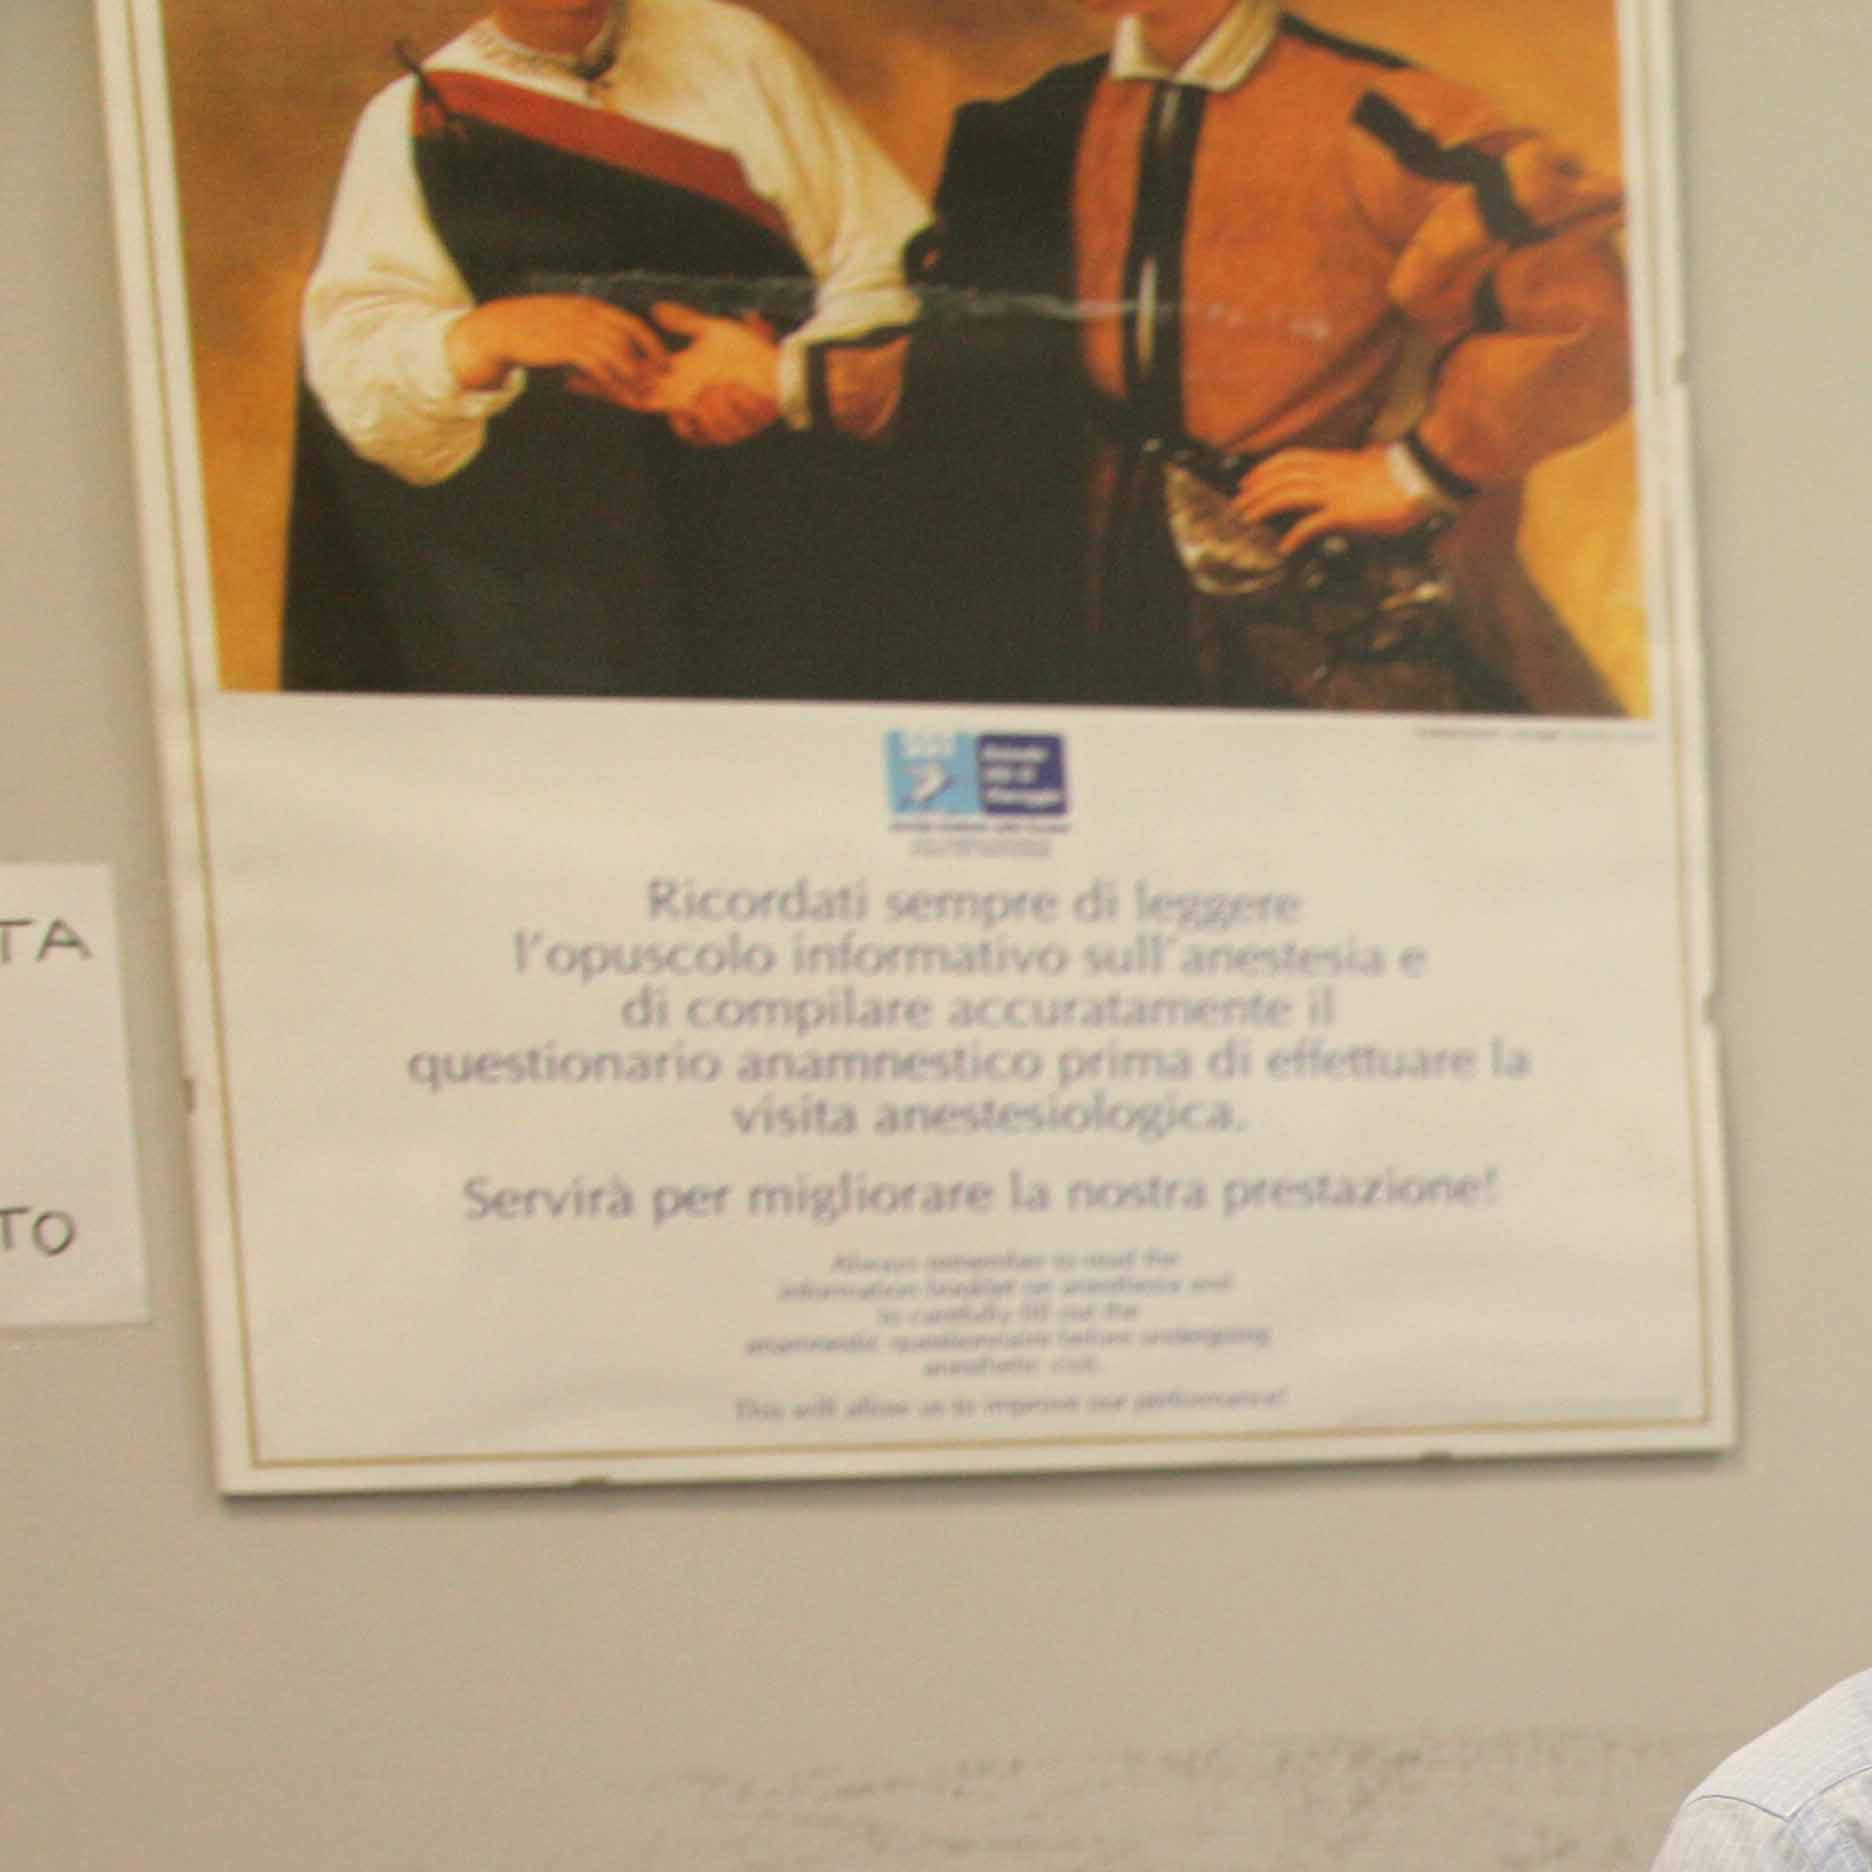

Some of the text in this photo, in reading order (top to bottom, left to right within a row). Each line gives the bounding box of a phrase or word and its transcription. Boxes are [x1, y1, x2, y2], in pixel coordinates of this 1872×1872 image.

[648, 878, 1304, 931] Ricordati sempre di leggere
[793, 929, 1069, 976] informativo
[1397, 942, 1427, 977] e
[620, 984, 1335, 1036] di compilare accuratamente il
[406, 1036, 1532, 1093] questionario anamnestico prima di effettuare la
[732, 1090, 1248, 1142] visita anestesiologica.
[463, 1167, 1498, 1226] Servirà per migliorare la nostra prestazione!
